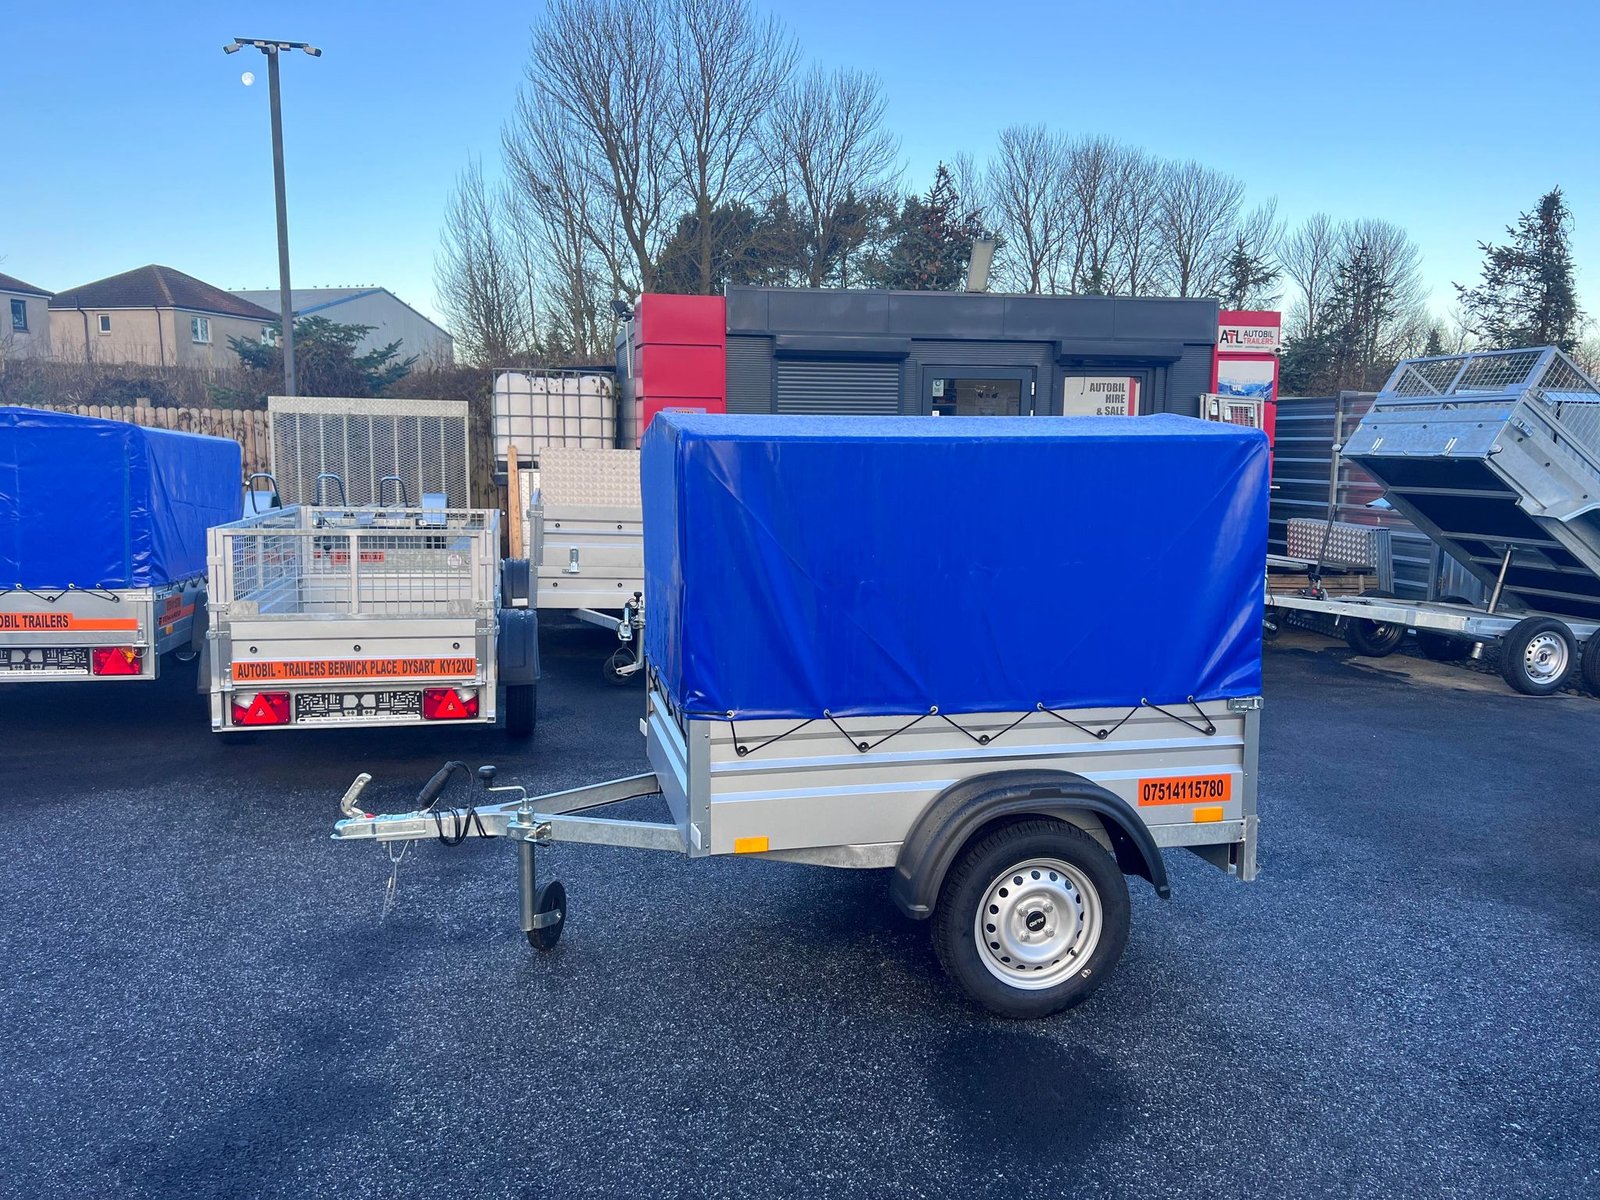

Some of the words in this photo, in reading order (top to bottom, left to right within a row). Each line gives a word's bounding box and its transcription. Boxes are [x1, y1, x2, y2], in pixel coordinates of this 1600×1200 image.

[1219, 329, 1243, 344] ATL
[1243, 330, 1274, 338] AUTOBIL
[1089, 382, 1126, 393] AUTOBIL
[1105, 393, 1126, 404] HIRE
[1096, 407, 1103, 416] &
[1104, 406, 1125, 416] SALE
[22, 614, 69, 628] TRAILERS
[237, 663, 276, 678] AUTOBIL
[283, 661, 326, 677] TRAILERS
[328, 660, 368, 676] BERWICK
[440, 658, 473, 673] KY12XU
[1143, 779, 1224, 801] 07514115780
